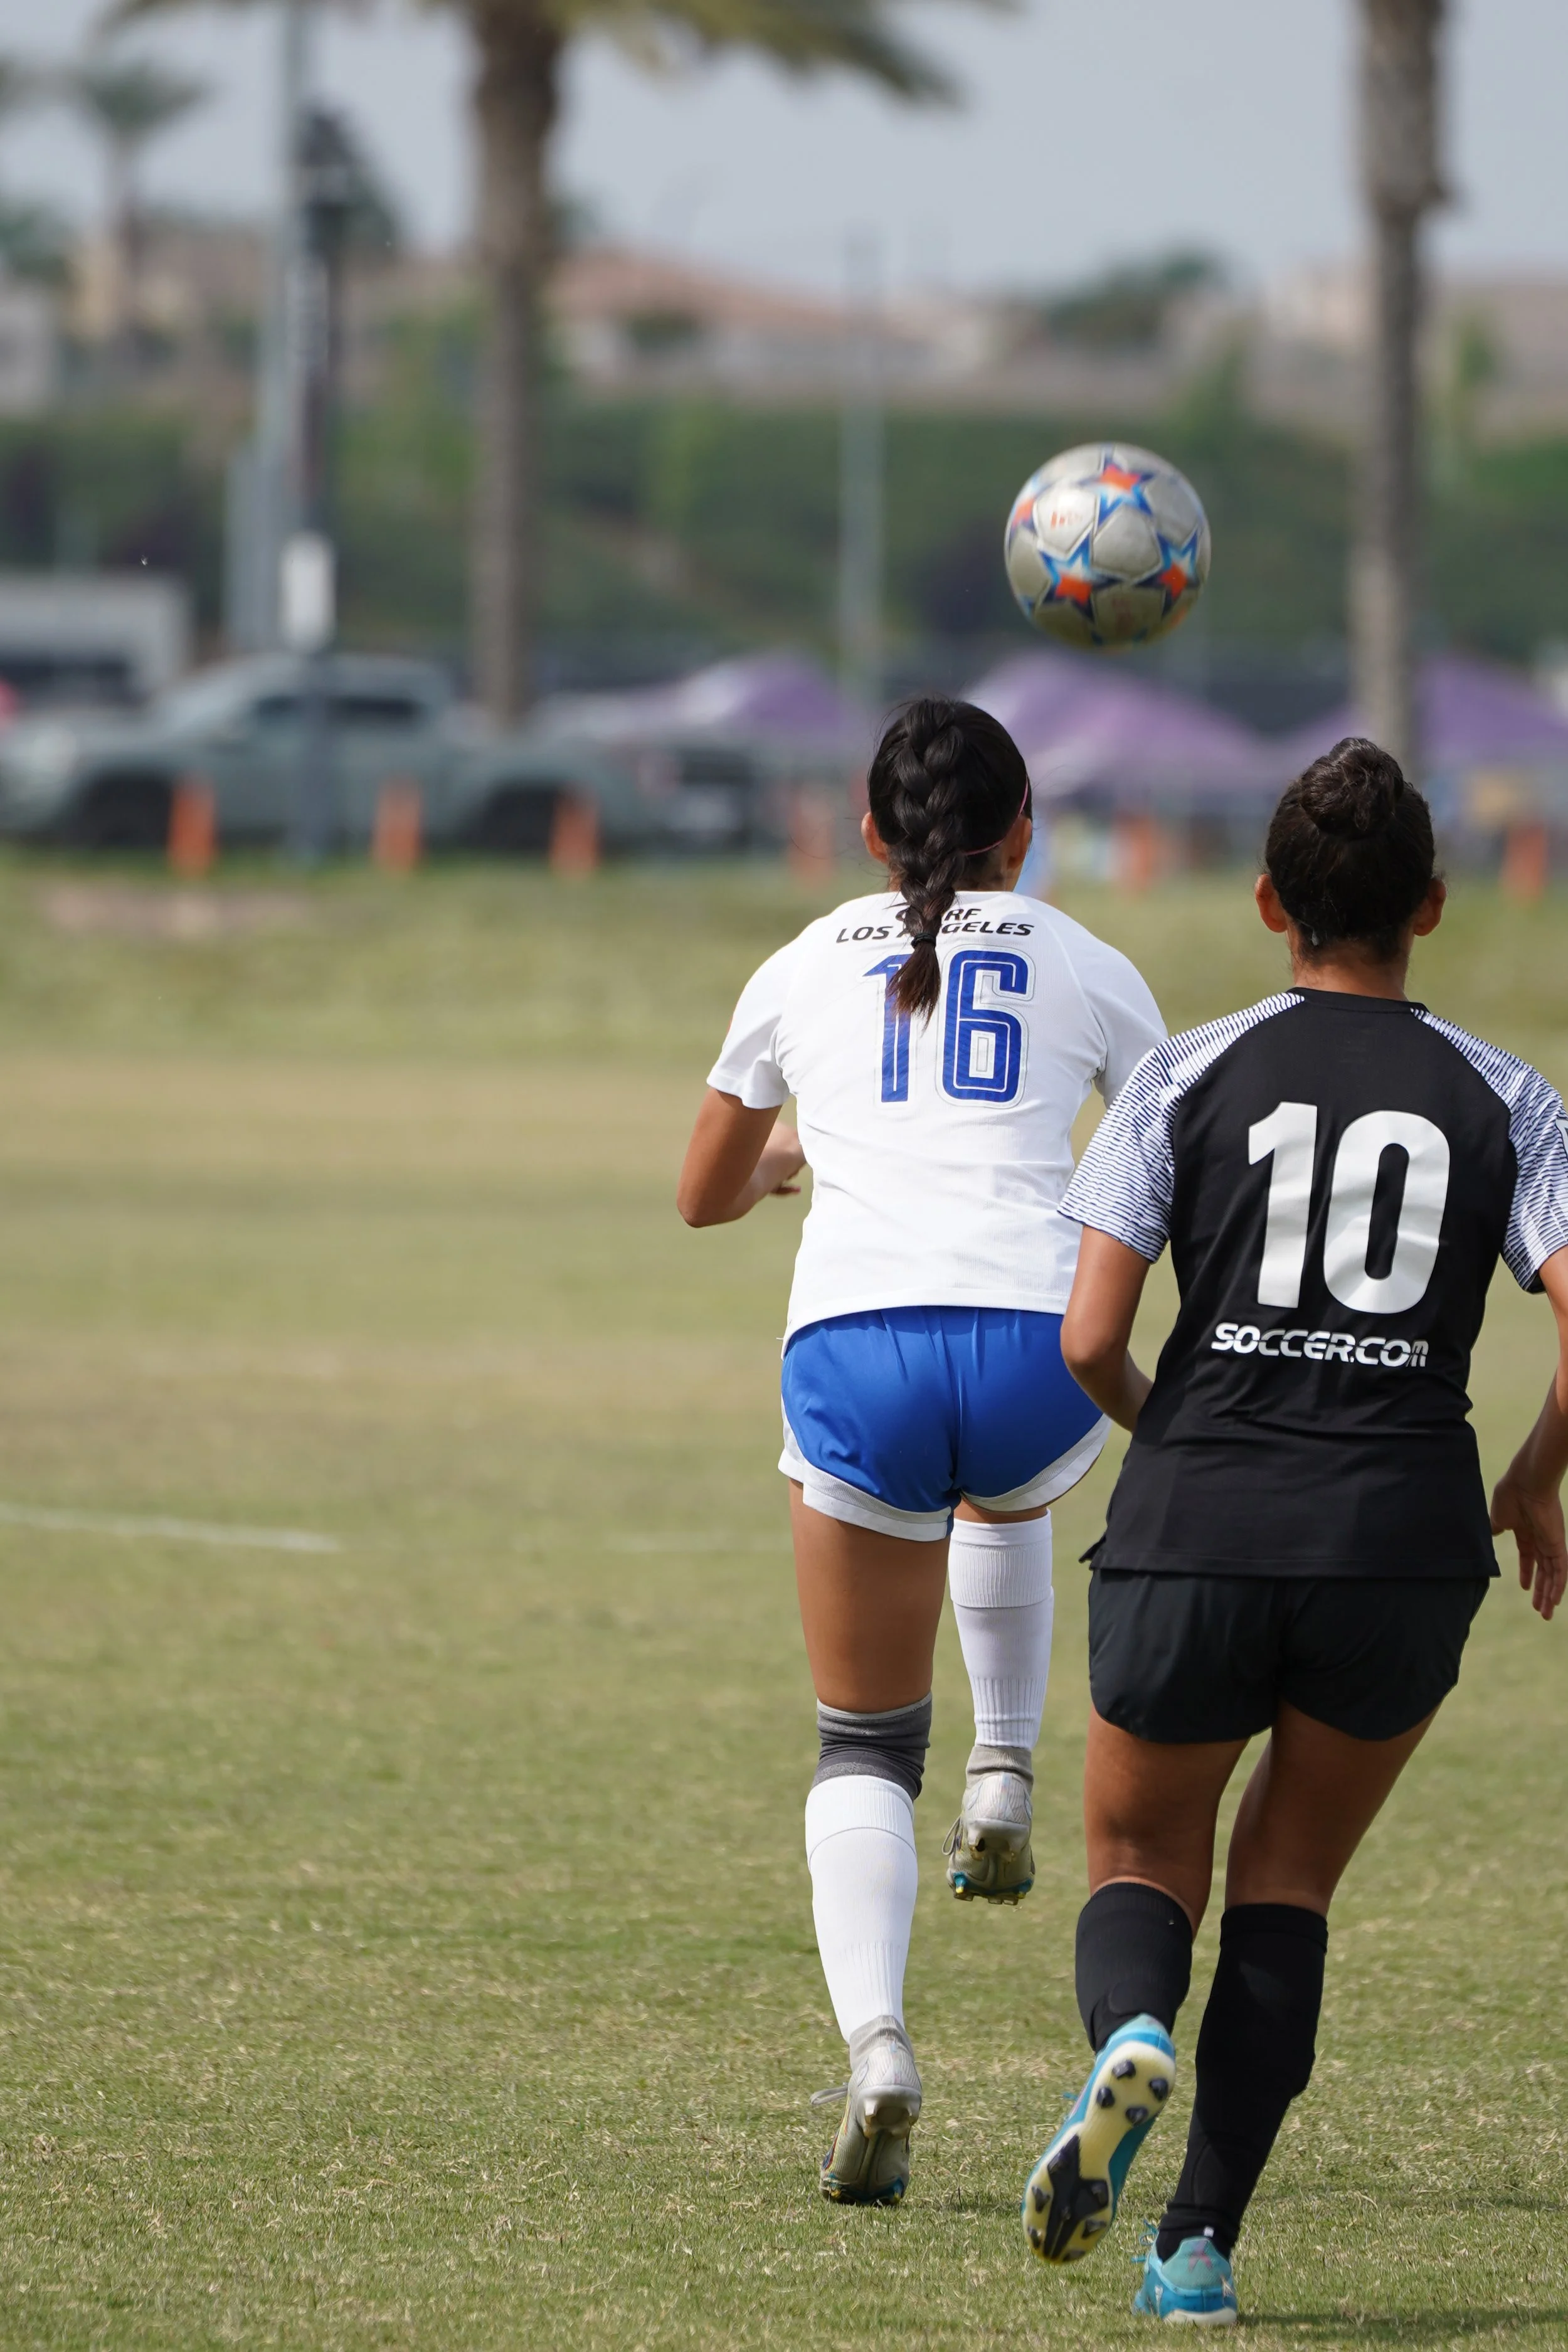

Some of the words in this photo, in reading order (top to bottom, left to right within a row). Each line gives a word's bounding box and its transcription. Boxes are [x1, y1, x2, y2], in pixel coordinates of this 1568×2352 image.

[836, 926, 893, 943] LOS
[896, 908, 982, 922] RF
[861, 948, 1031, 1105] 16
[1248, 1101, 1451, 1314] 10
[1210, 1322, 1429, 1367] SOCCER.COM
